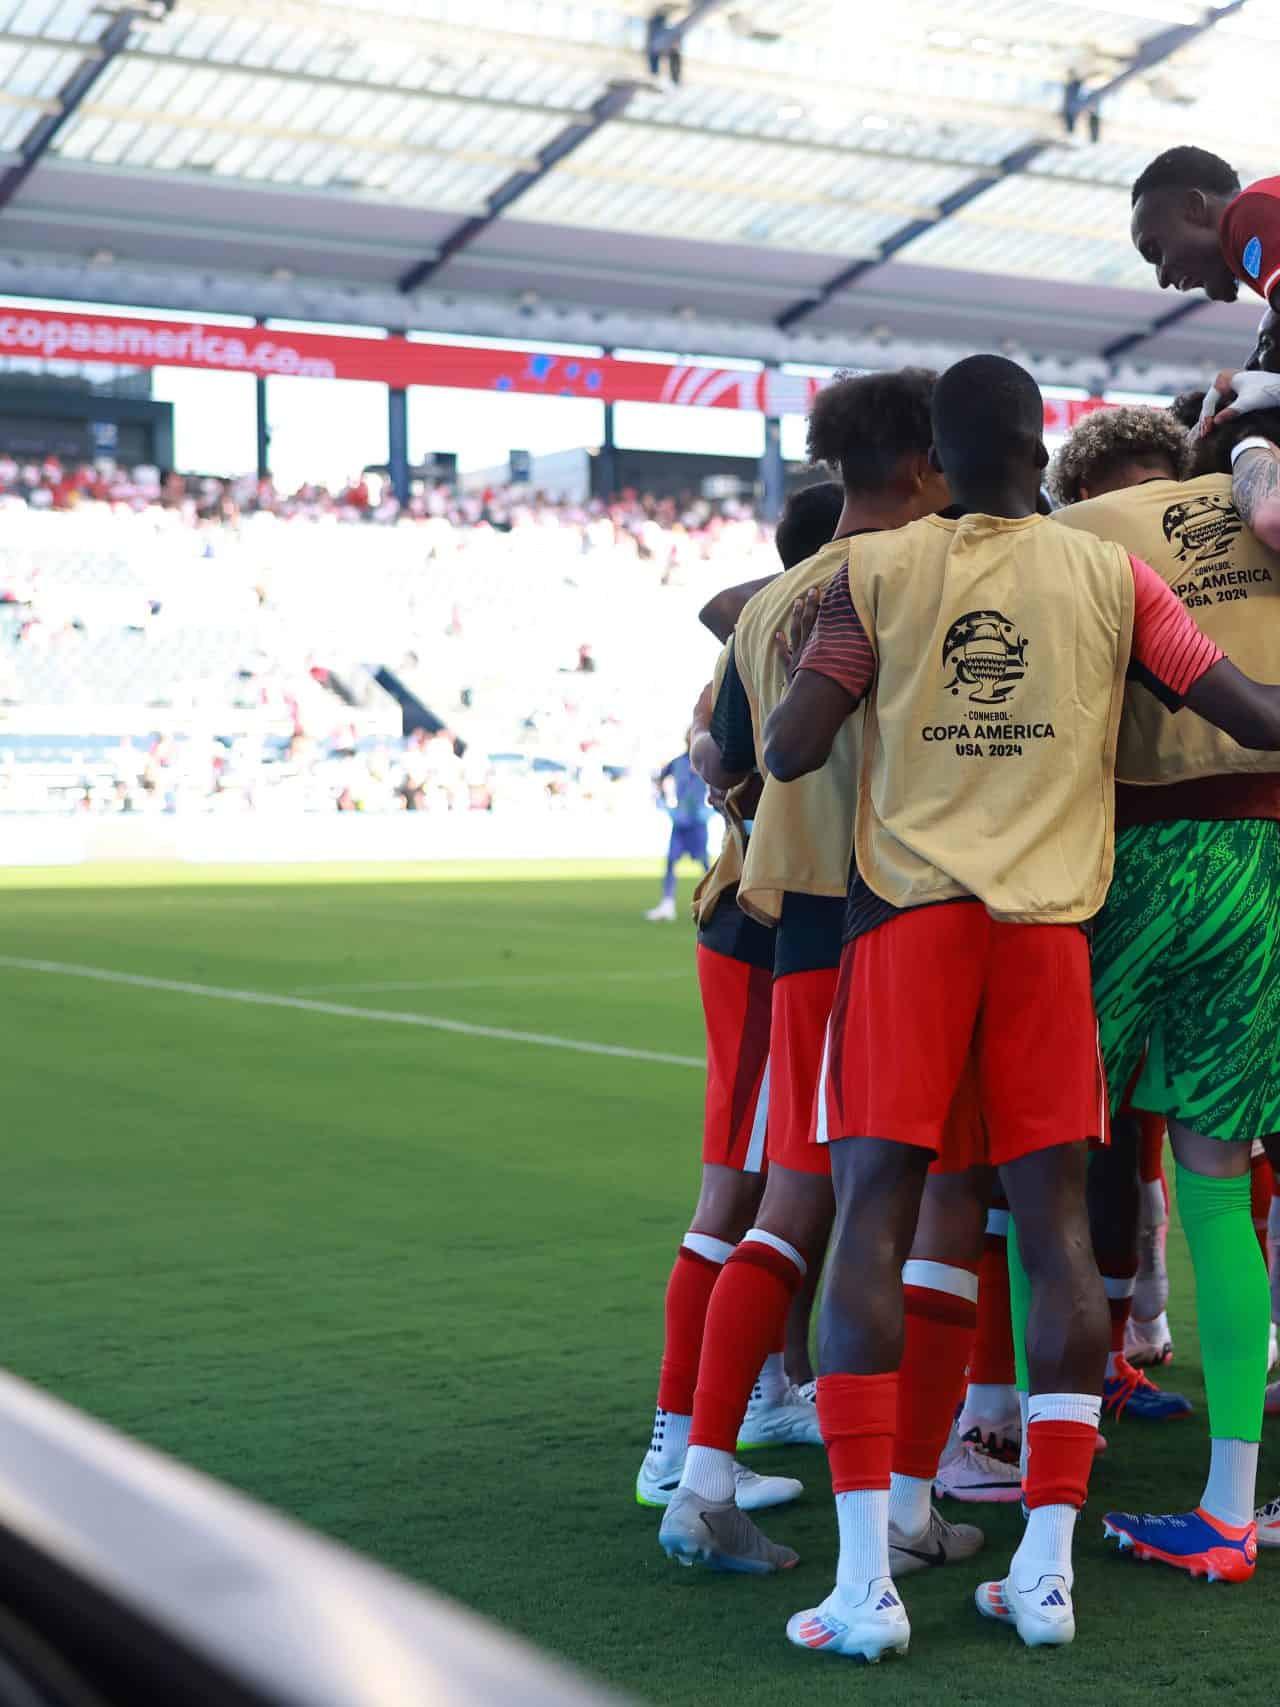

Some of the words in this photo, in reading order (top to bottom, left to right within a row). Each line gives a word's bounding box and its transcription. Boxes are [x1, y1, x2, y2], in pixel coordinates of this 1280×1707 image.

[1172, 581, 1199, 597] PA
[1201, 567, 1272, 591] AMERICA
[1186, 596, 1212, 609] USA
[1216, 588, 1248, 603] 2024
[922, 724, 970, 742] COPA
[974, 723, 1056, 740] AMERICA
[955, 743, 983, 757] USA
[989, 743, 1023, 757] 2024
